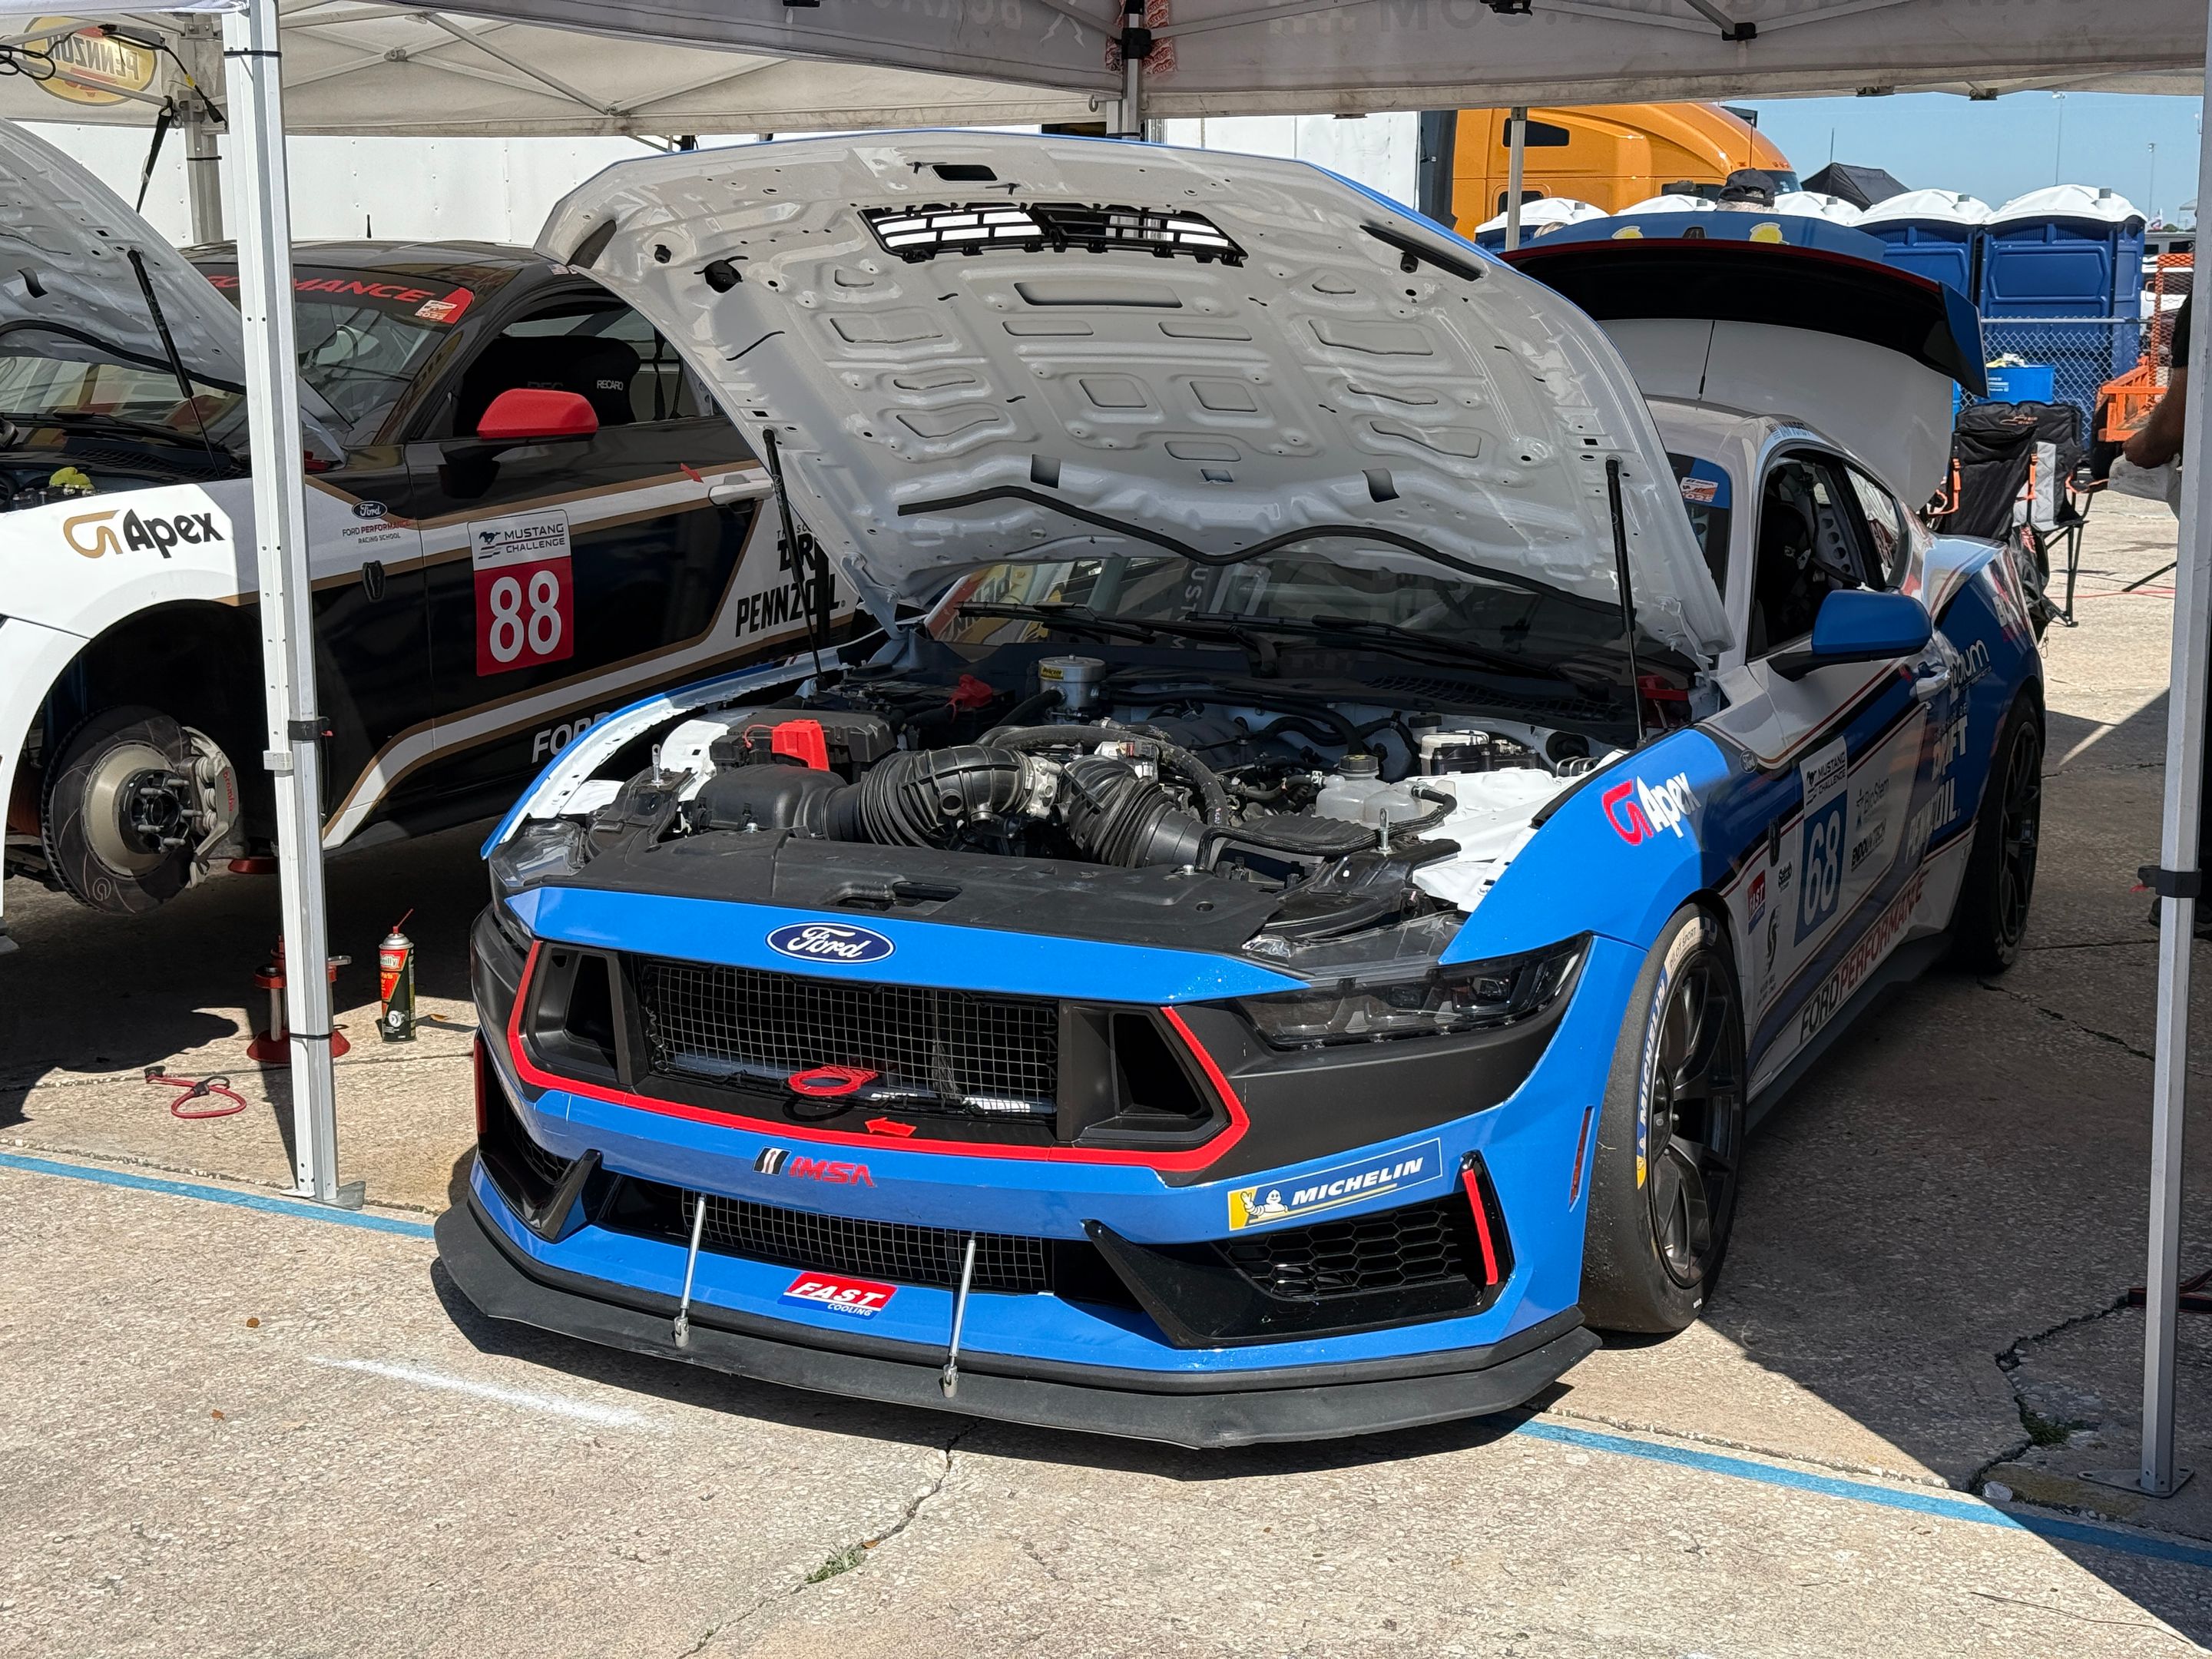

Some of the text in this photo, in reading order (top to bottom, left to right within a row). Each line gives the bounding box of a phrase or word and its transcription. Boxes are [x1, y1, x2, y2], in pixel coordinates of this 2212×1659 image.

[596, 379, 624, 391] RECARO
[359, 503, 382, 516] Ford
[123, 508, 226, 559] Apex
[342, 521, 412, 536] FORD PERFORMANCE
[358, 532, 401, 544] RACING SCHOOL
[504, 523, 565, 541] MUSTANG
[505, 538, 565, 553] CHALLENGE
[489, 570, 562, 663] 88
[531, 711, 612, 763] FOR
[1817, 752, 1846, 779] MUSTANG
[1818, 769, 1846, 795] CHALLENGE
[223, 770, 234, 812] brembo
[1636, 772, 1702, 839] Apex
[1805, 810, 1841, 926] 68
[1749, 883, 1765, 912] FAST
[786, 926, 873, 959] Ford
[1670, 926, 1697, 970] PILOT SPORT
[1800, 972, 1839, 1045] FORD
[1638, 979, 1667, 1128] MICHELIN
[788, 1155, 876, 1188] IMSA
[1290, 1157, 1424, 1207] MICHELIN
[792, 1282, 886, 1306] FAST
[827, 1303, 873, 1316] COOLING
